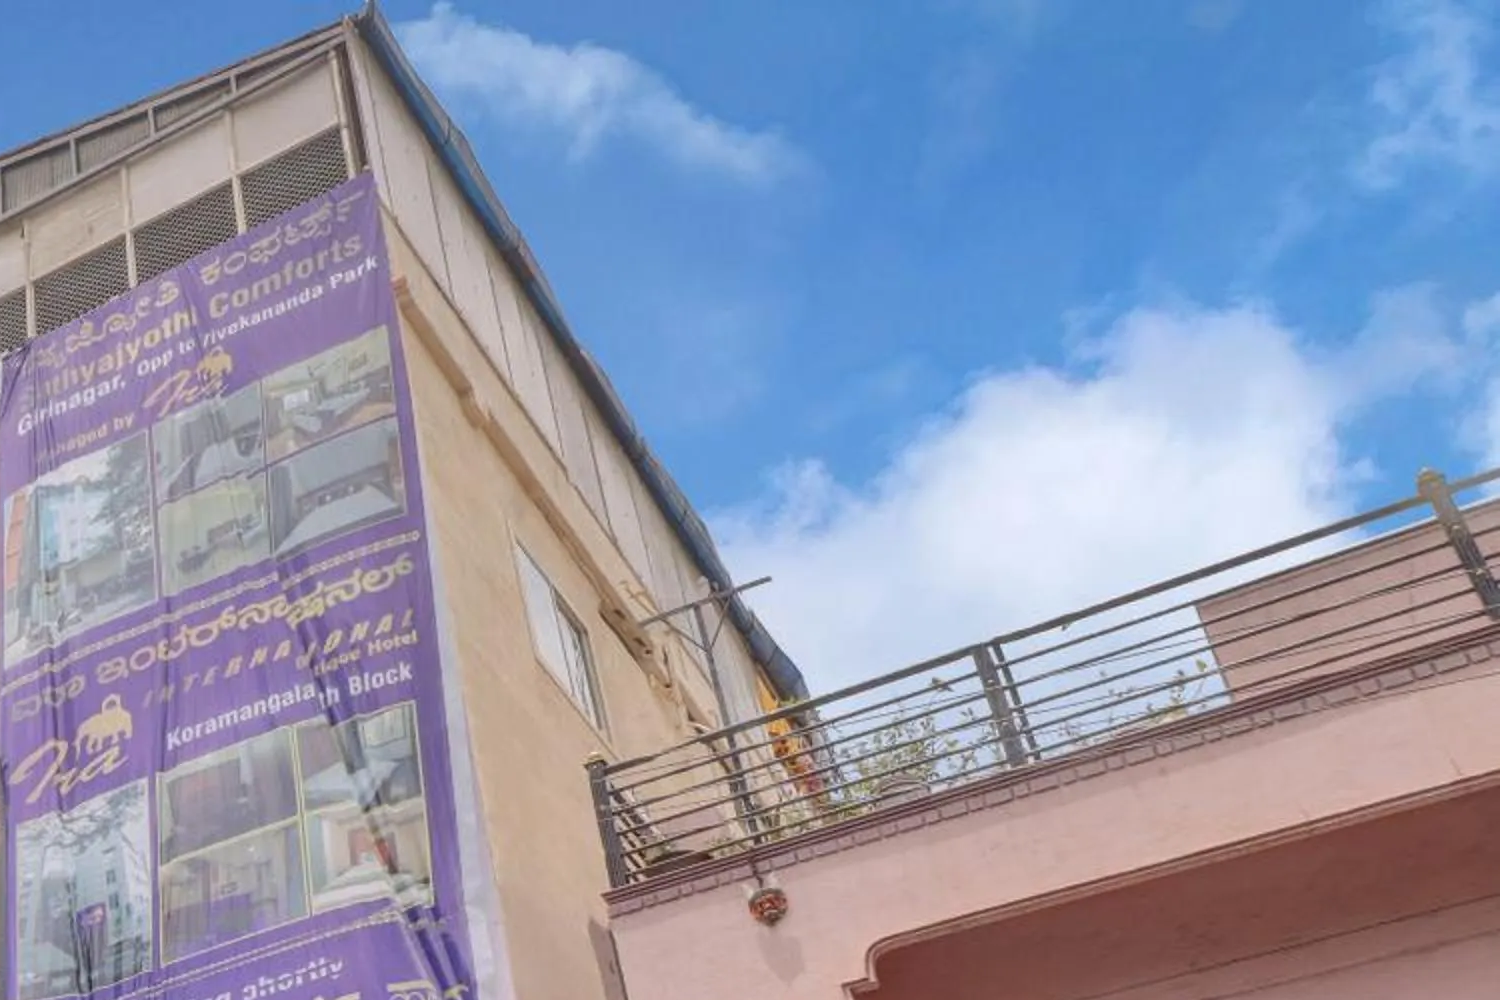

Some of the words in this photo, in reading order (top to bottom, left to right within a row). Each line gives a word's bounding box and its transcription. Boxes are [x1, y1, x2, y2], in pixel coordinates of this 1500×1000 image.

[209, 235, 362, 319] Comforts
[17, 373, 126, 436] Girinagar,
[136, 350, 173, 376] Opp
[179, 337, 196, 355] to
[329, 255, 378, 289] Park
[113, 412, 135, 432] by
[143, 608, 414, 709] INTERNAIONAL
[367, 629, 418, 657] Hotel
[167, 683, 316, 751] Koramangala
[348, 660, 413, 696] Block
